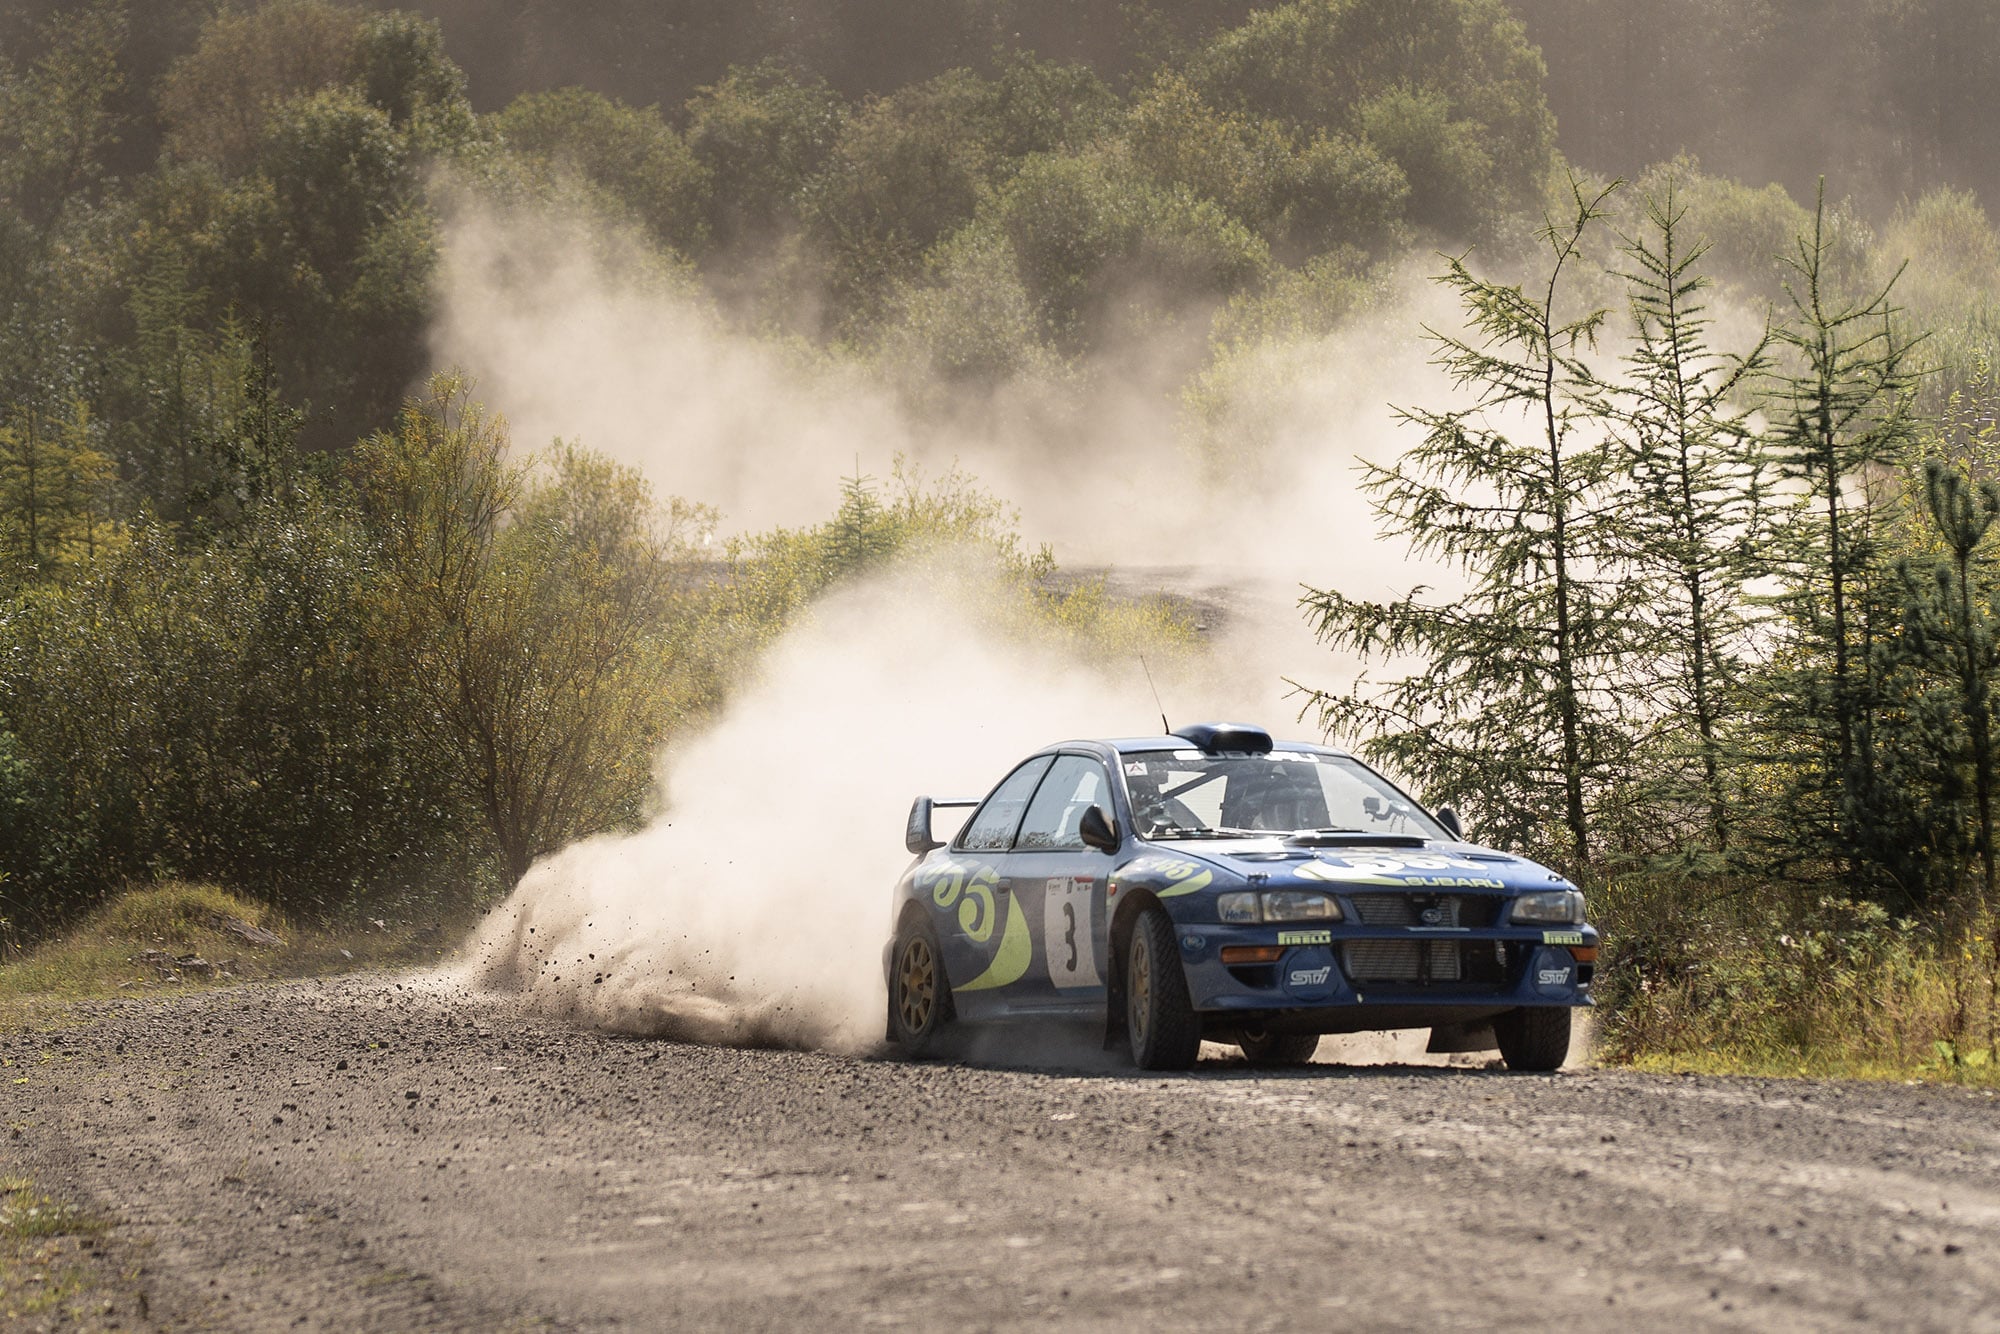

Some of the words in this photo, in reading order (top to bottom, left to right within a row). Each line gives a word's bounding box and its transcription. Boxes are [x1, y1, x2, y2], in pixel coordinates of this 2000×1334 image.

[1405, 876, 1506, 889] SUBARU
[1062, 901, 1078, 973] 3
[1277, 929, 1332, 946] PIRELLI
[1542, 930, 1584, 945] PIRELLI
